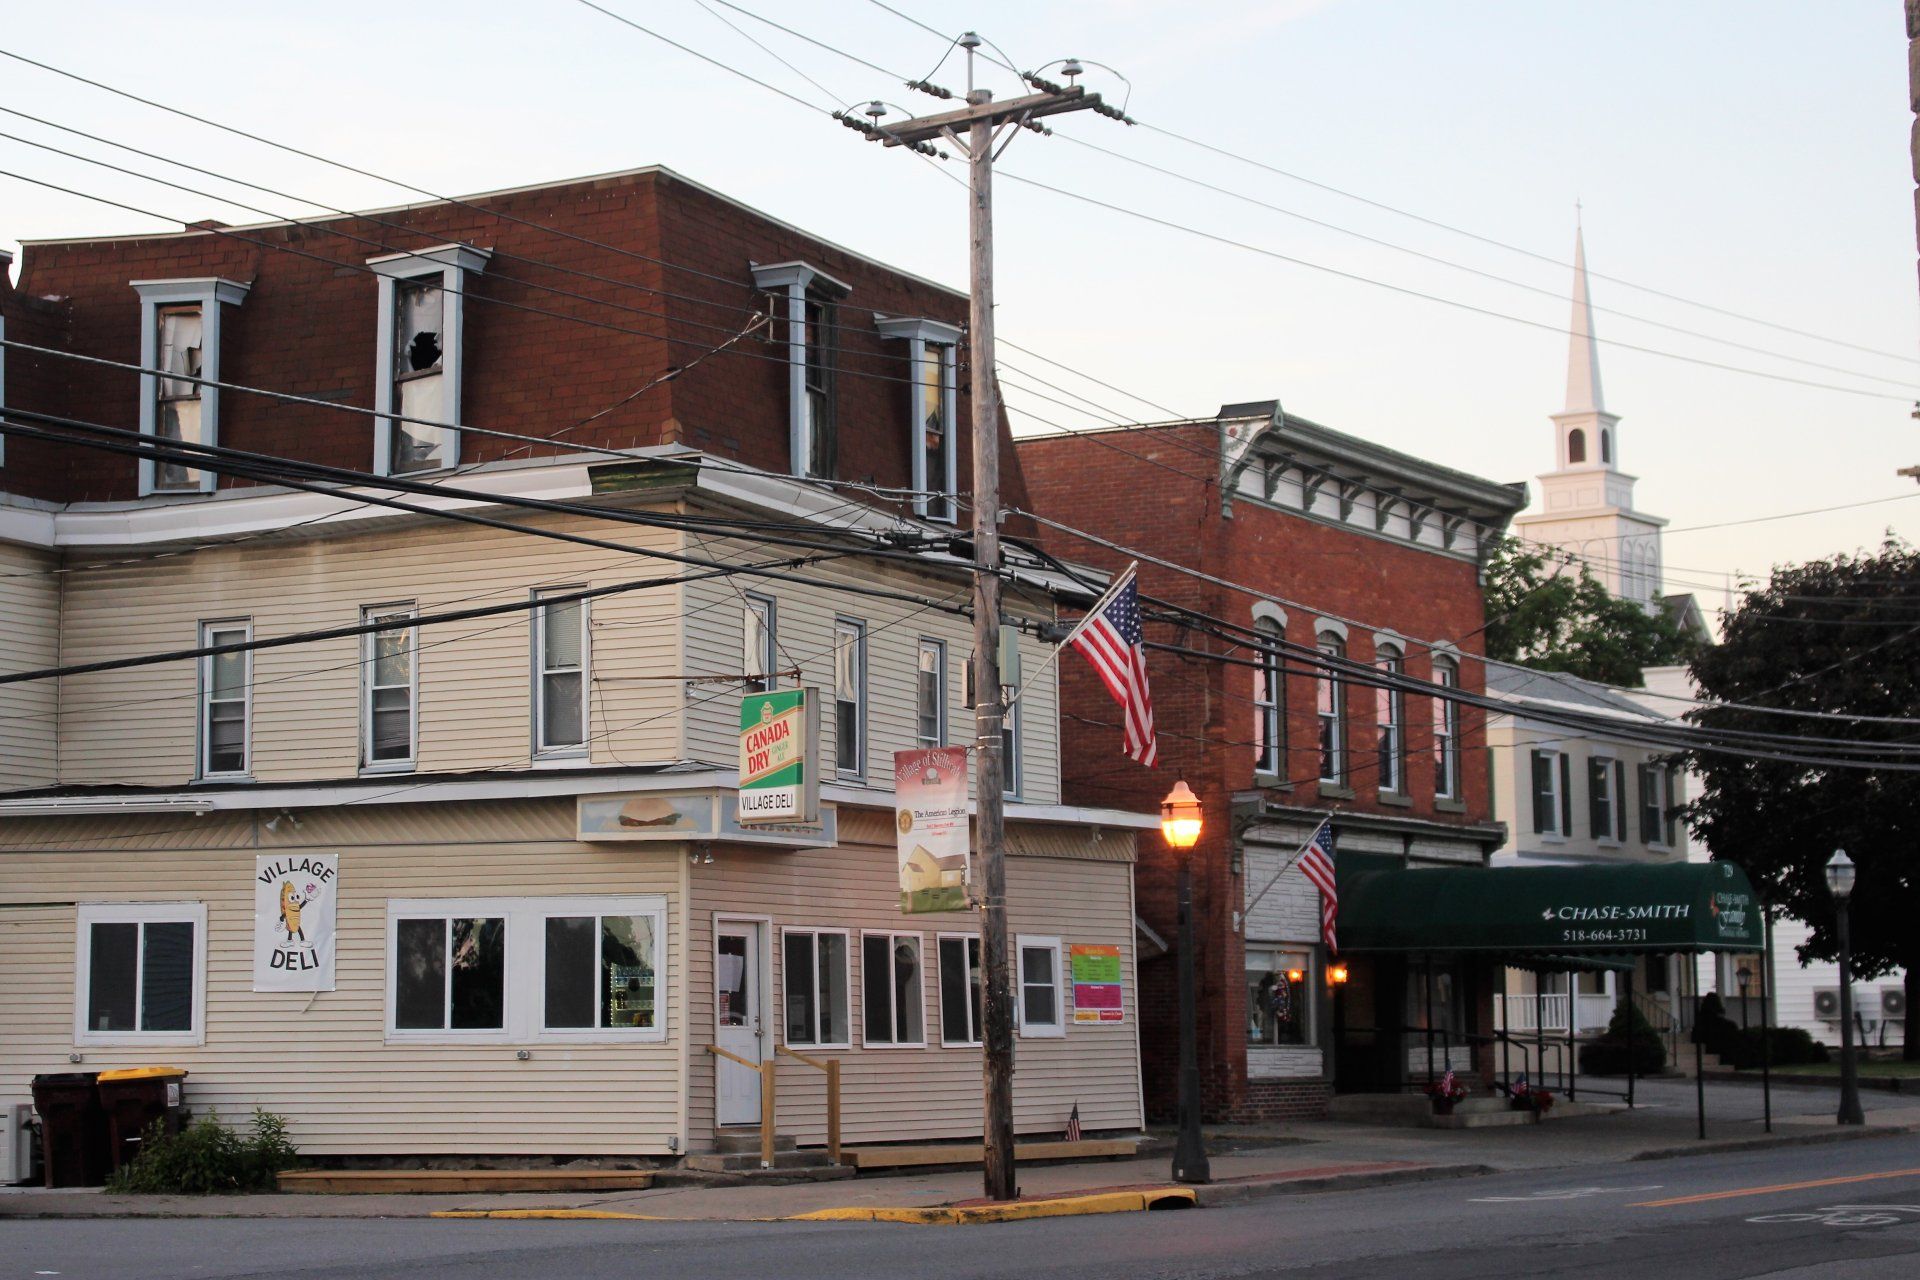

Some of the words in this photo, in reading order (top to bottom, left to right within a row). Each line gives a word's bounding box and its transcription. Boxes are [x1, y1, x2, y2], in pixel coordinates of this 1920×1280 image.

[746, 720, 790, 753] CANADA
[747, 749, 770, 774] DRY
[896, 759, 921, 782] Village
[922, 751, 931, 766] of
[932, 751, 961, 777] Stillwat
[742, 795, 774, 811] VILLAGE
[776, 793, 793, 809] DELI
[914, 810, 924, 818] The
[925, 809, 947, 817] American
[948, 807, 966, 817] Legion
[258, 858, 335, 884] VILLAGE
[1558, 904, 1690, 920] CHASE-SMITH
[1563, 928, 1647, 941] 518-664-3731
[270, 948, 319, 970] DELI
